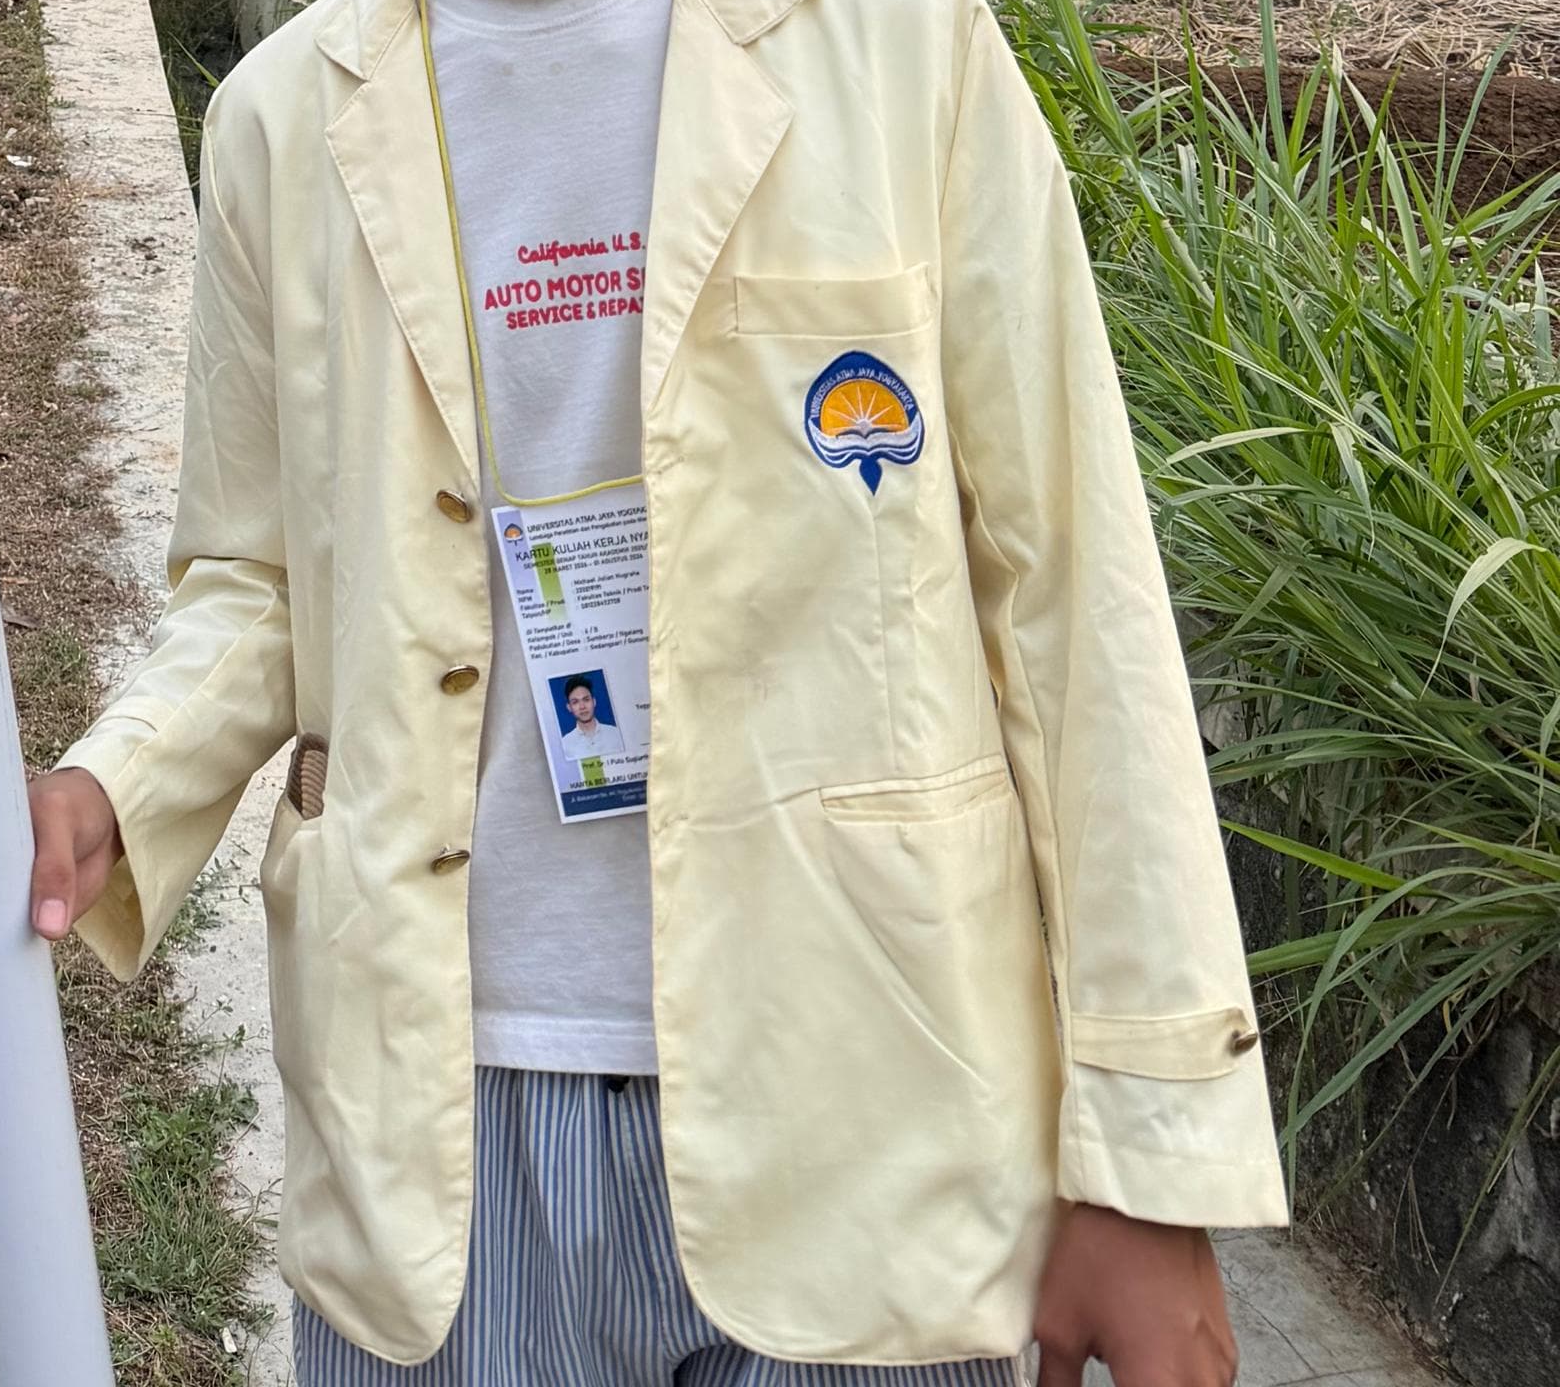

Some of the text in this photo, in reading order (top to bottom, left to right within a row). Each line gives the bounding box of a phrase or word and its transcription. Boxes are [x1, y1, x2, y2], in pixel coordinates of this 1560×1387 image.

[518, 240, 608, 266] California
[485, 268, 645, 310] AUTO MOTOR S
[506, 304, 583, 329] SERVICE
[587, 302, 596, 319] &
[515, 547, 549, 562] KARTU
[553, 540, 591, 555] KULIAH
[593, 535, 628, 548] KERJA
